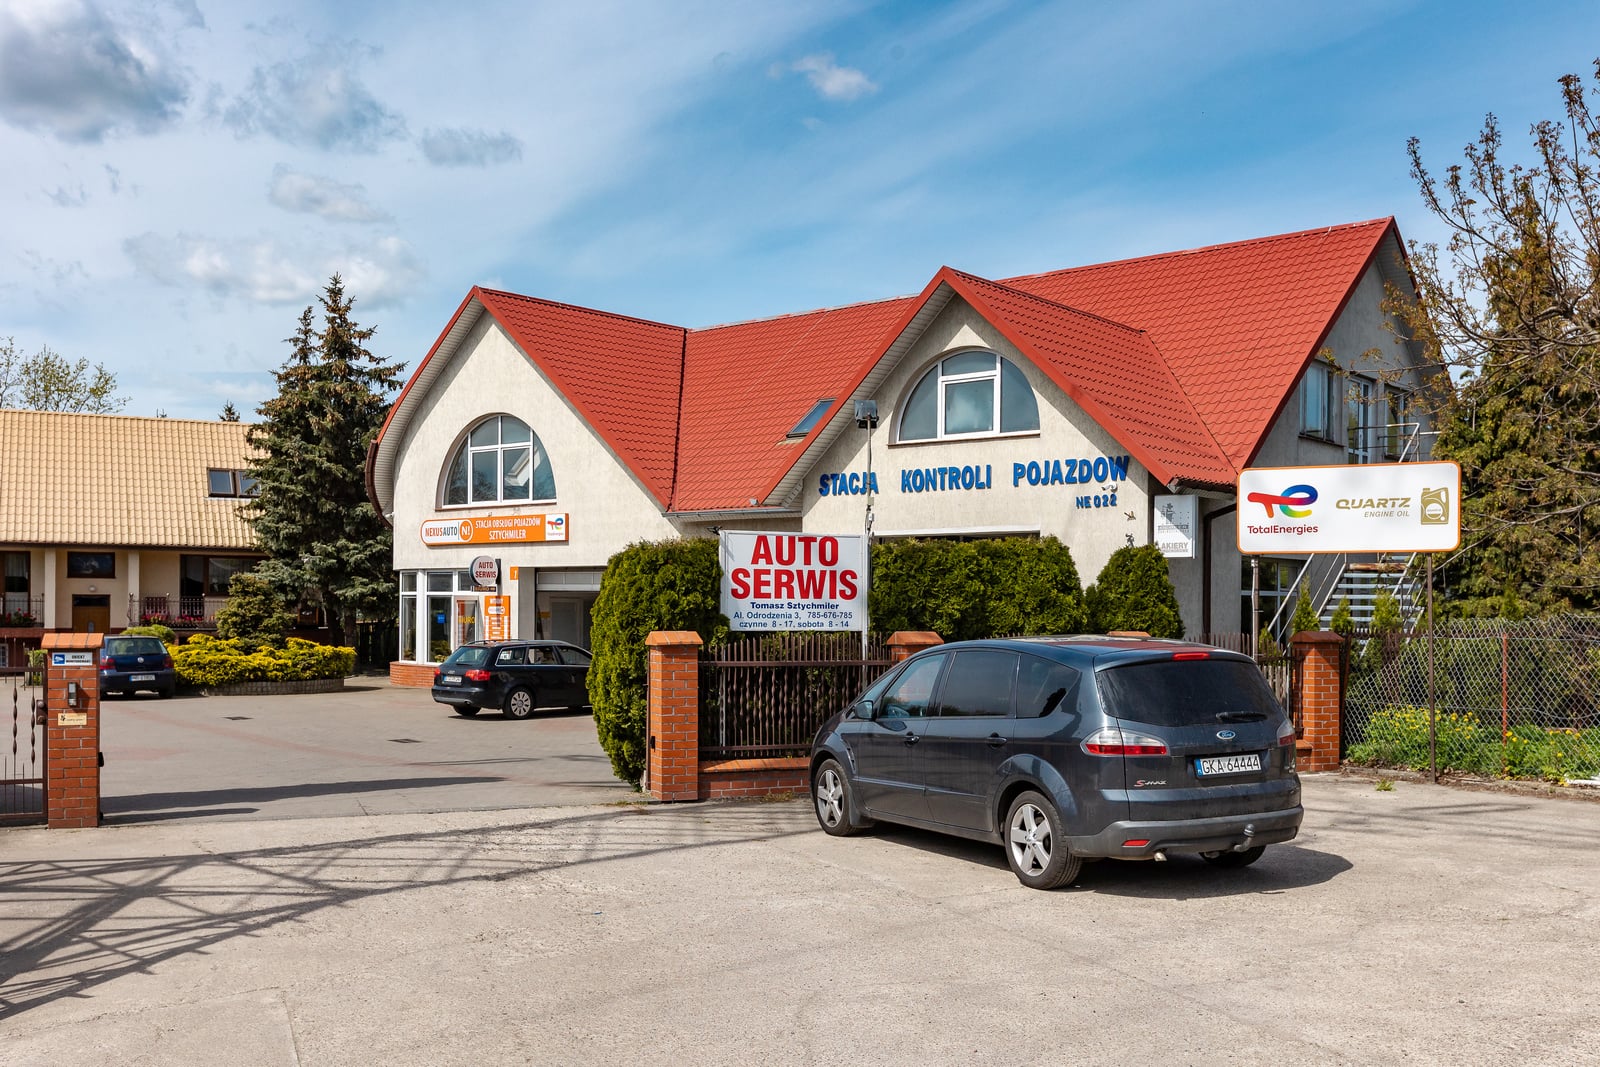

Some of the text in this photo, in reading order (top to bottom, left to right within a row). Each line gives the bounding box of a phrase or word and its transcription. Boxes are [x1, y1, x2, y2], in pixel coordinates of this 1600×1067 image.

[818, 455, 1130, 497] STACJA KONTROLI POJAZDOW
[1335, 497, 1412, 510] QUARTZ
[475, 520, 493, 529] STACJA
[1247, 524, 1319, 536] TotalEnergies
[425, 526, 458, 537] NEXUSAUTO
[488, 529, 527, 540] SZTYCHMILER
[751, 535, 839, 567] AUTO
[1156, 542, 1189, 550] AKIERY
[478, 561, 494, 569] AUTO
[475, 570, 497, 579] SERWIS
[730, 567, 858, 601] SERWIS
[787, 602, 840, 611] Sztychmiler
[746, 611, 793, 619] Odrodzenia
[794, 612, 802, 620] 3,
[807, 611, 853, 619] 785-676-785
[1202, 754, 1260, 774] GKA 64444
